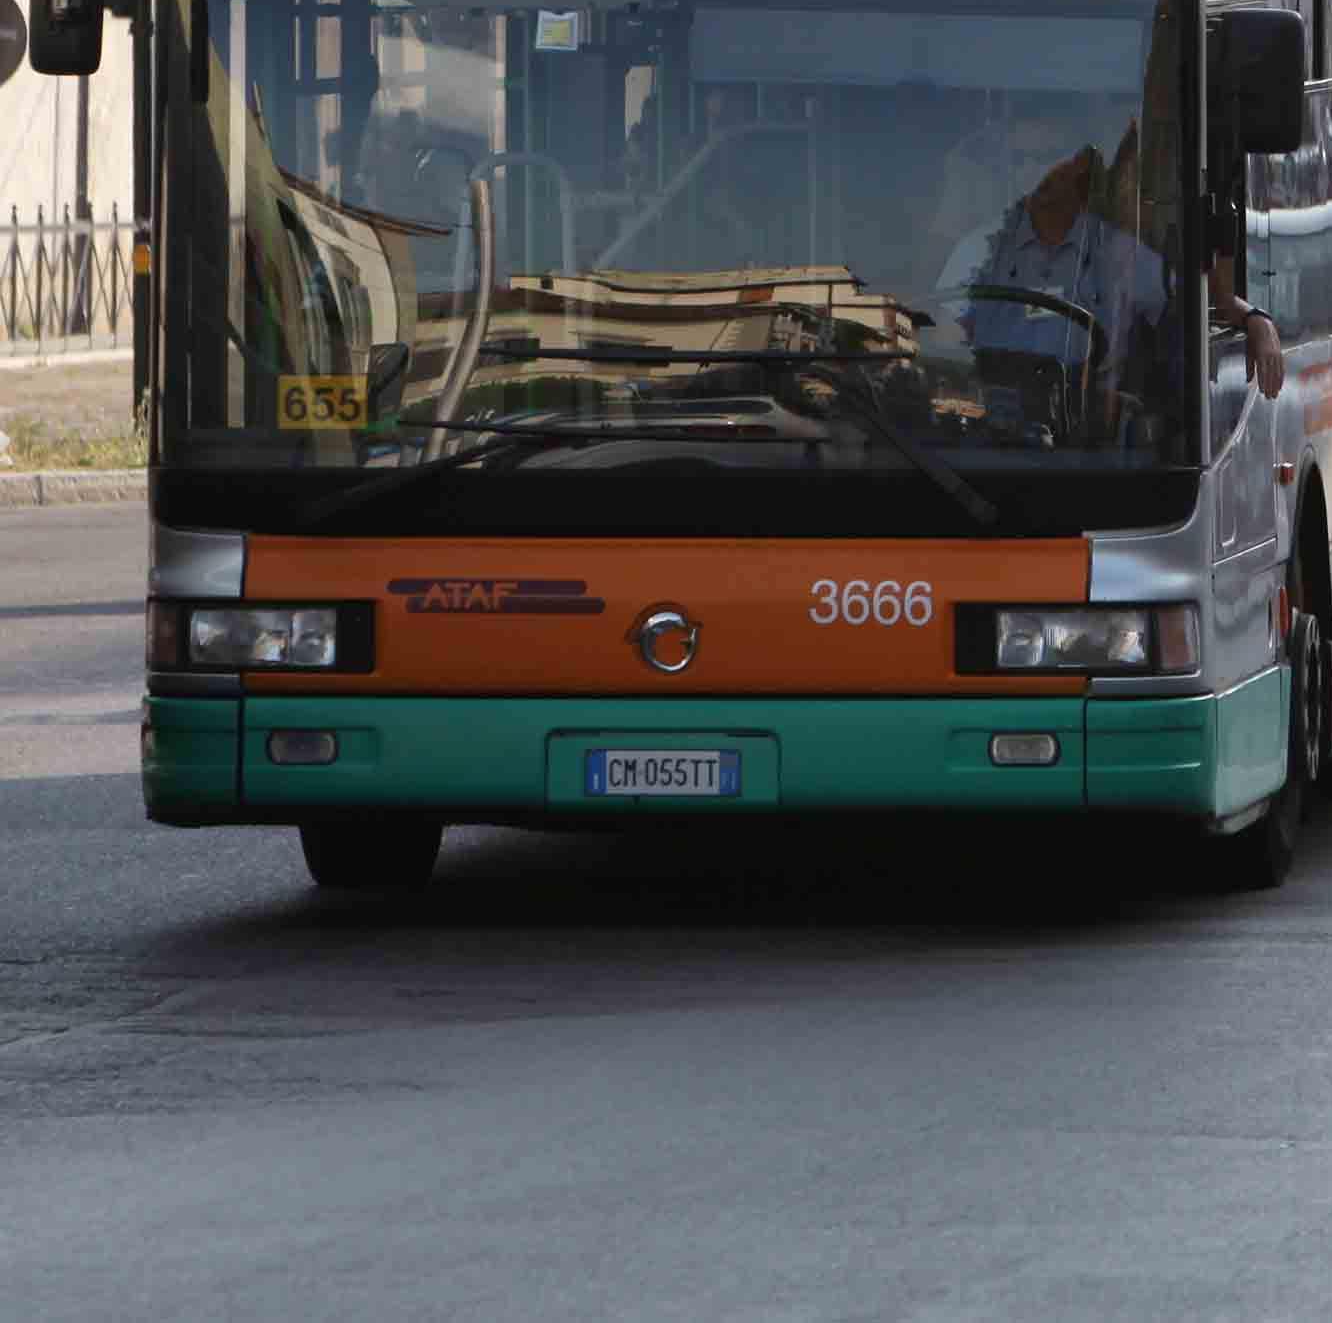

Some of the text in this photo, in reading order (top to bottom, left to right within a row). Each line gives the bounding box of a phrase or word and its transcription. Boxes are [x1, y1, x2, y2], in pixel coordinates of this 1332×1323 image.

[285, 385, 362, 422] 655
[423, 582, 518, 610] ATAF
[808, 580, 933, 626] 3666
